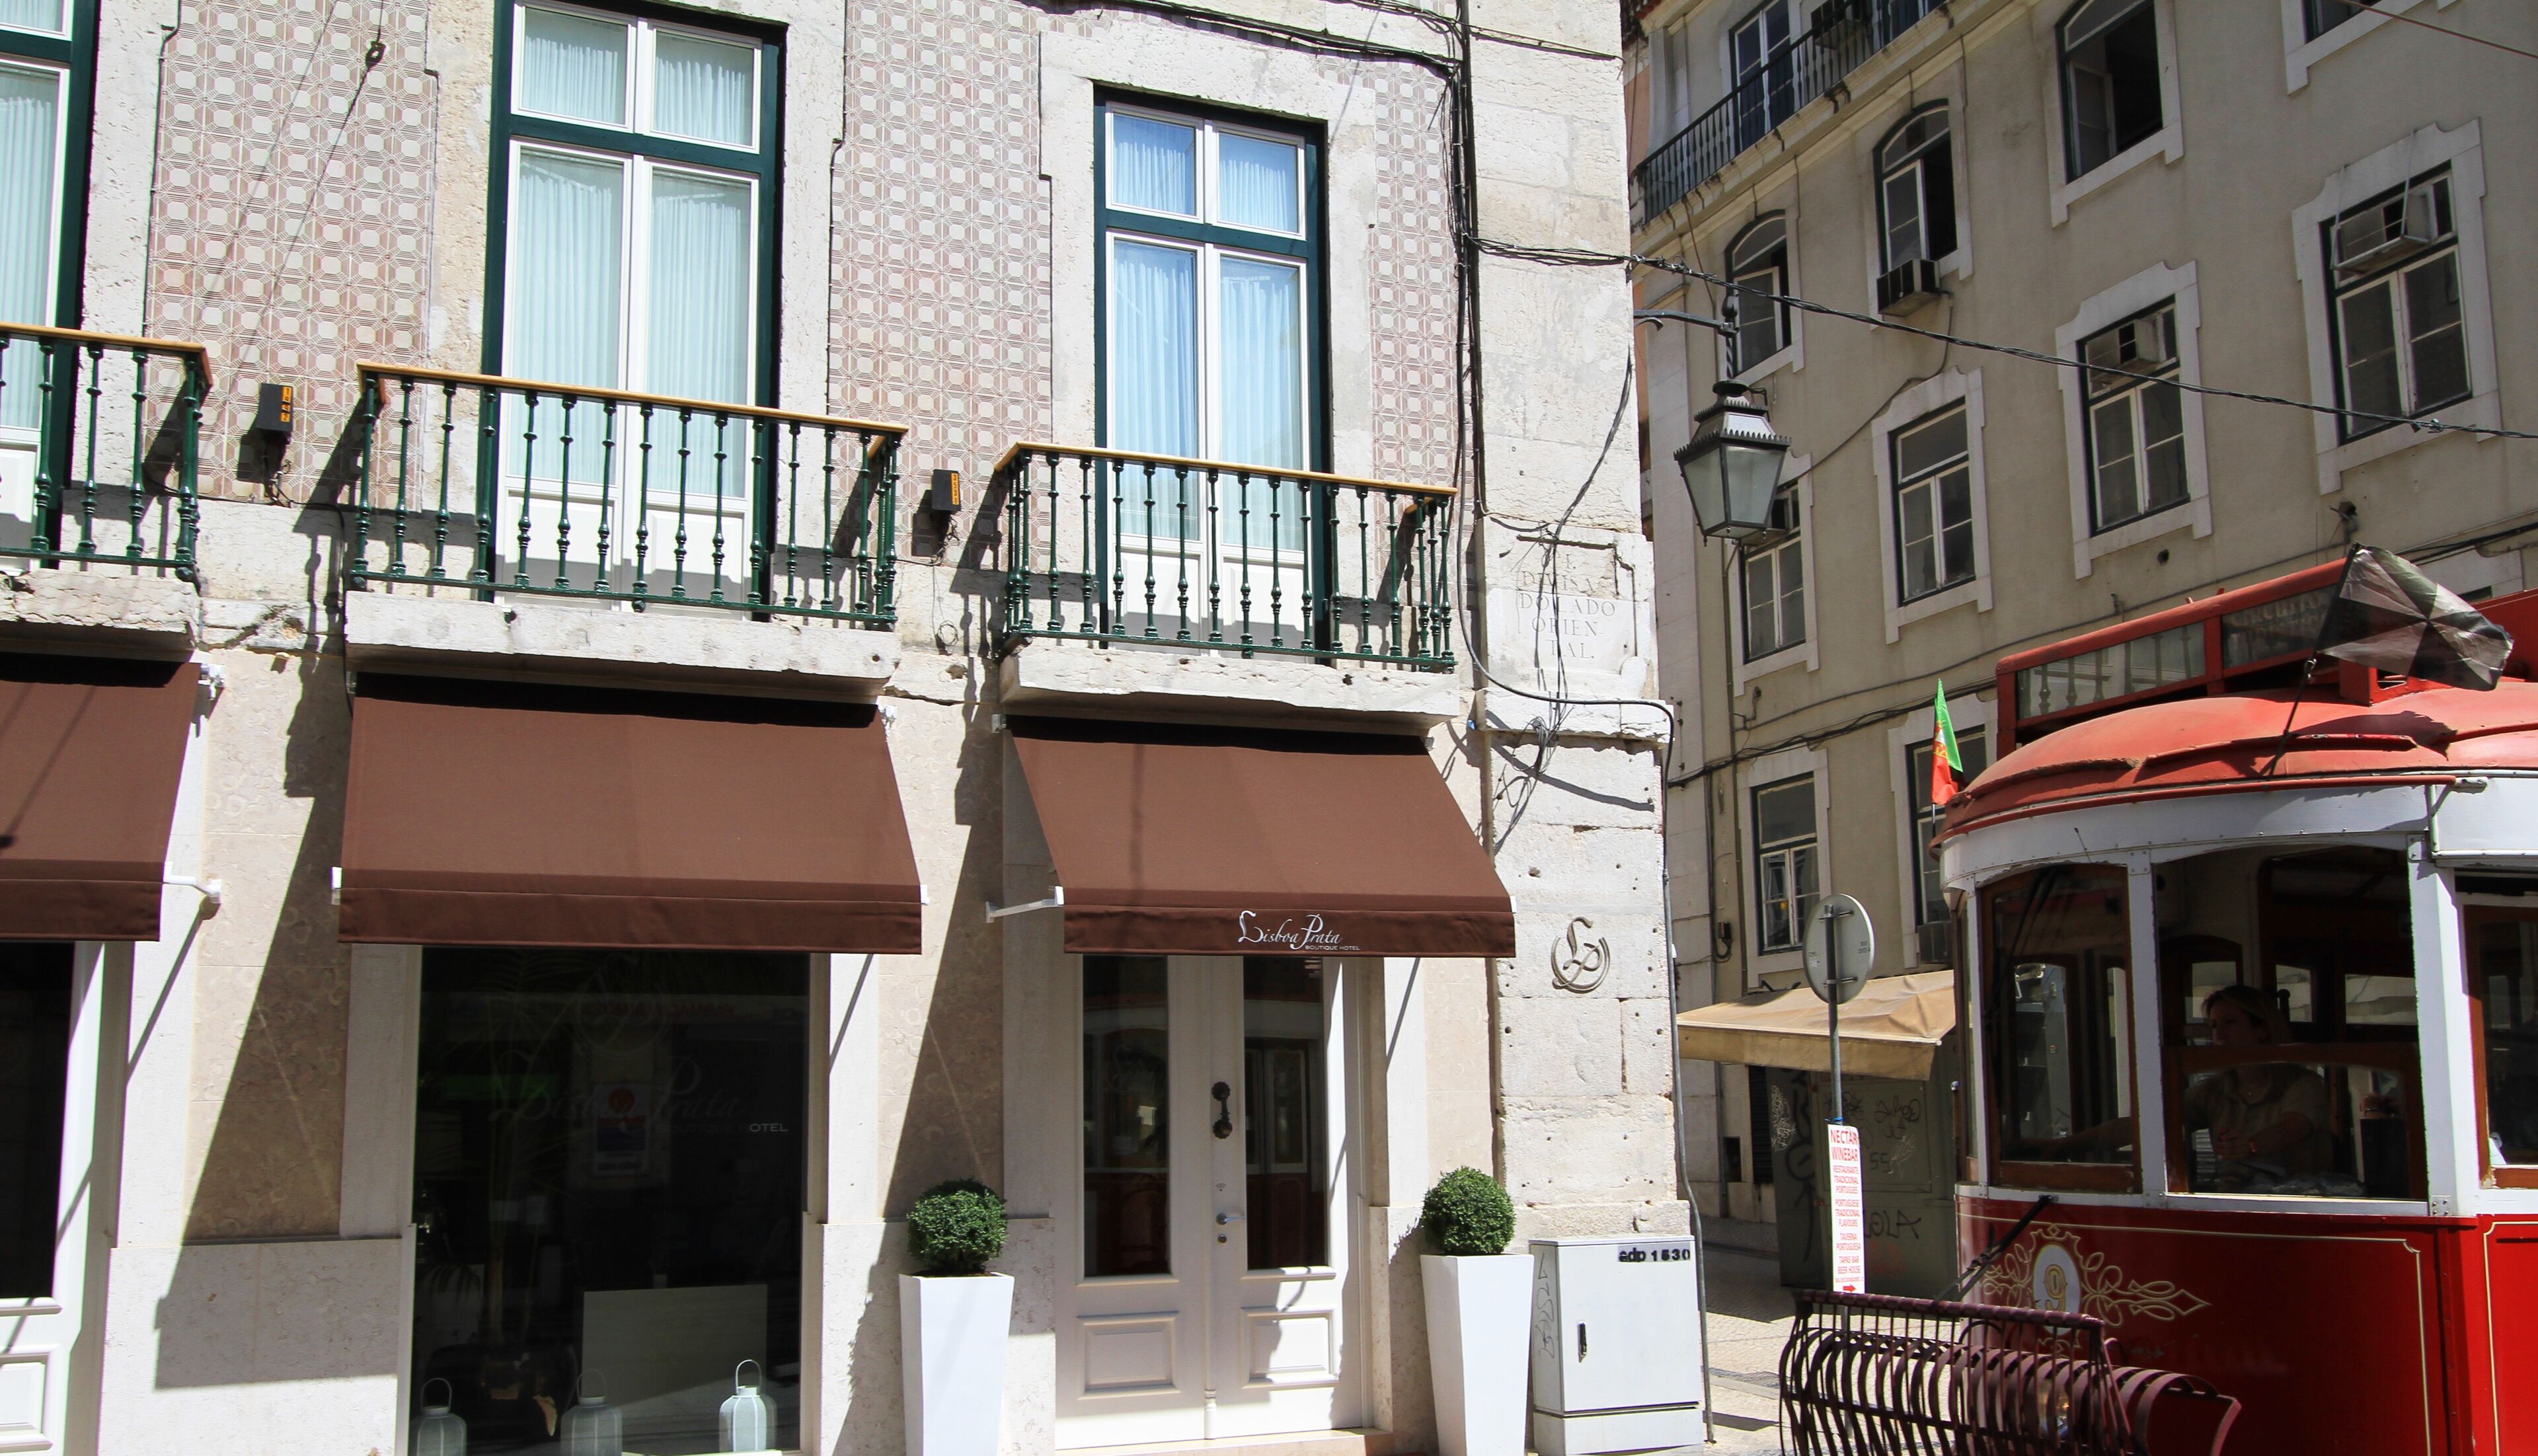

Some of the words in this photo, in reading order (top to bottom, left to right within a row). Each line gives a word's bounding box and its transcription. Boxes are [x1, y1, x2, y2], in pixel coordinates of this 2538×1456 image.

[1237, 910, 1299, 944] Lisboa
[1289, 913, 1342, 950] Prata
[1830, 1130, 1859, 1145] NECTAR
[1831, 1147, 1859, 1162] WINEBAR
[1651, 1248, 1691, 1262] 1530
